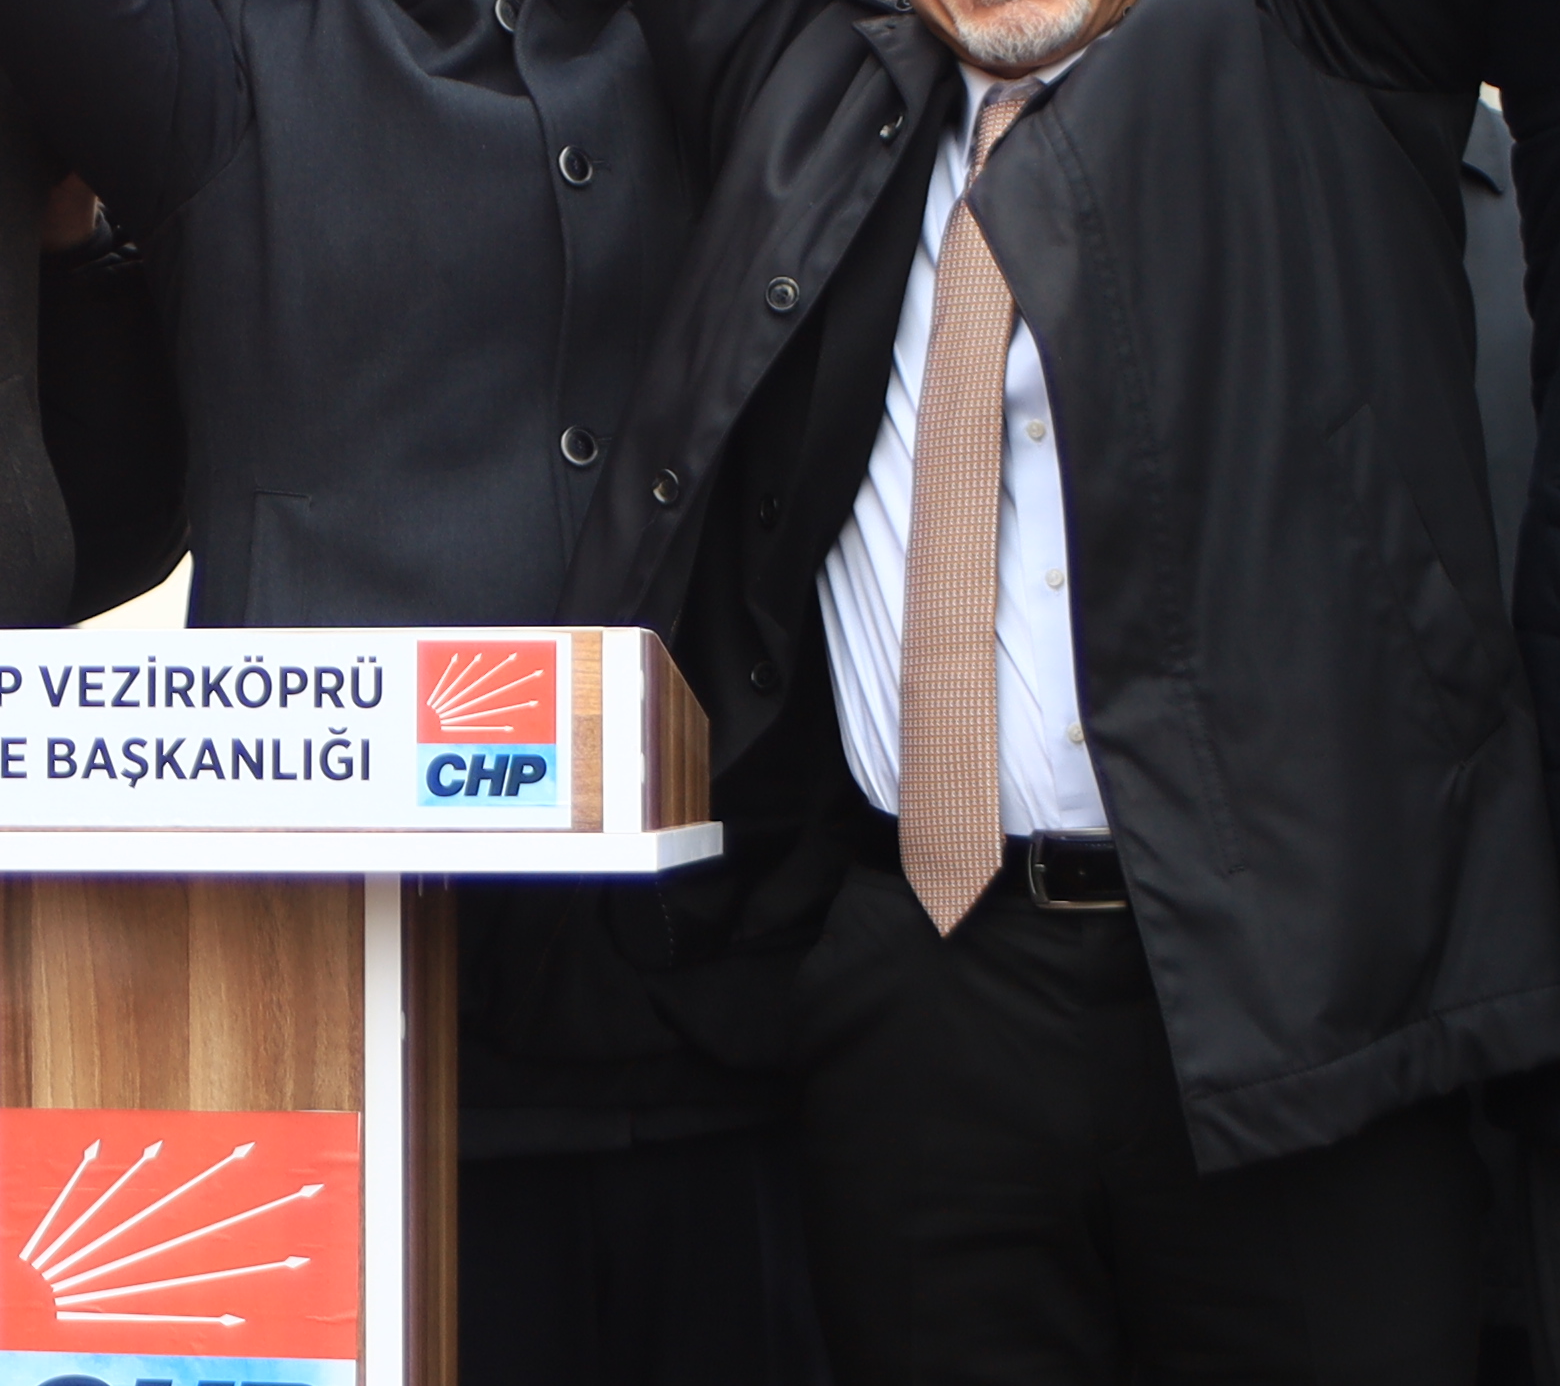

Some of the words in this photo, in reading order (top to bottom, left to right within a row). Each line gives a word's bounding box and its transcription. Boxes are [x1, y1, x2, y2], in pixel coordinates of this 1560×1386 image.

[43, 655, 385, 709] VEZİRKÖPRÜ
[46, 728, 372, 789] BAŞKANLIĞI
[425, 753, 548, 799] CHP
